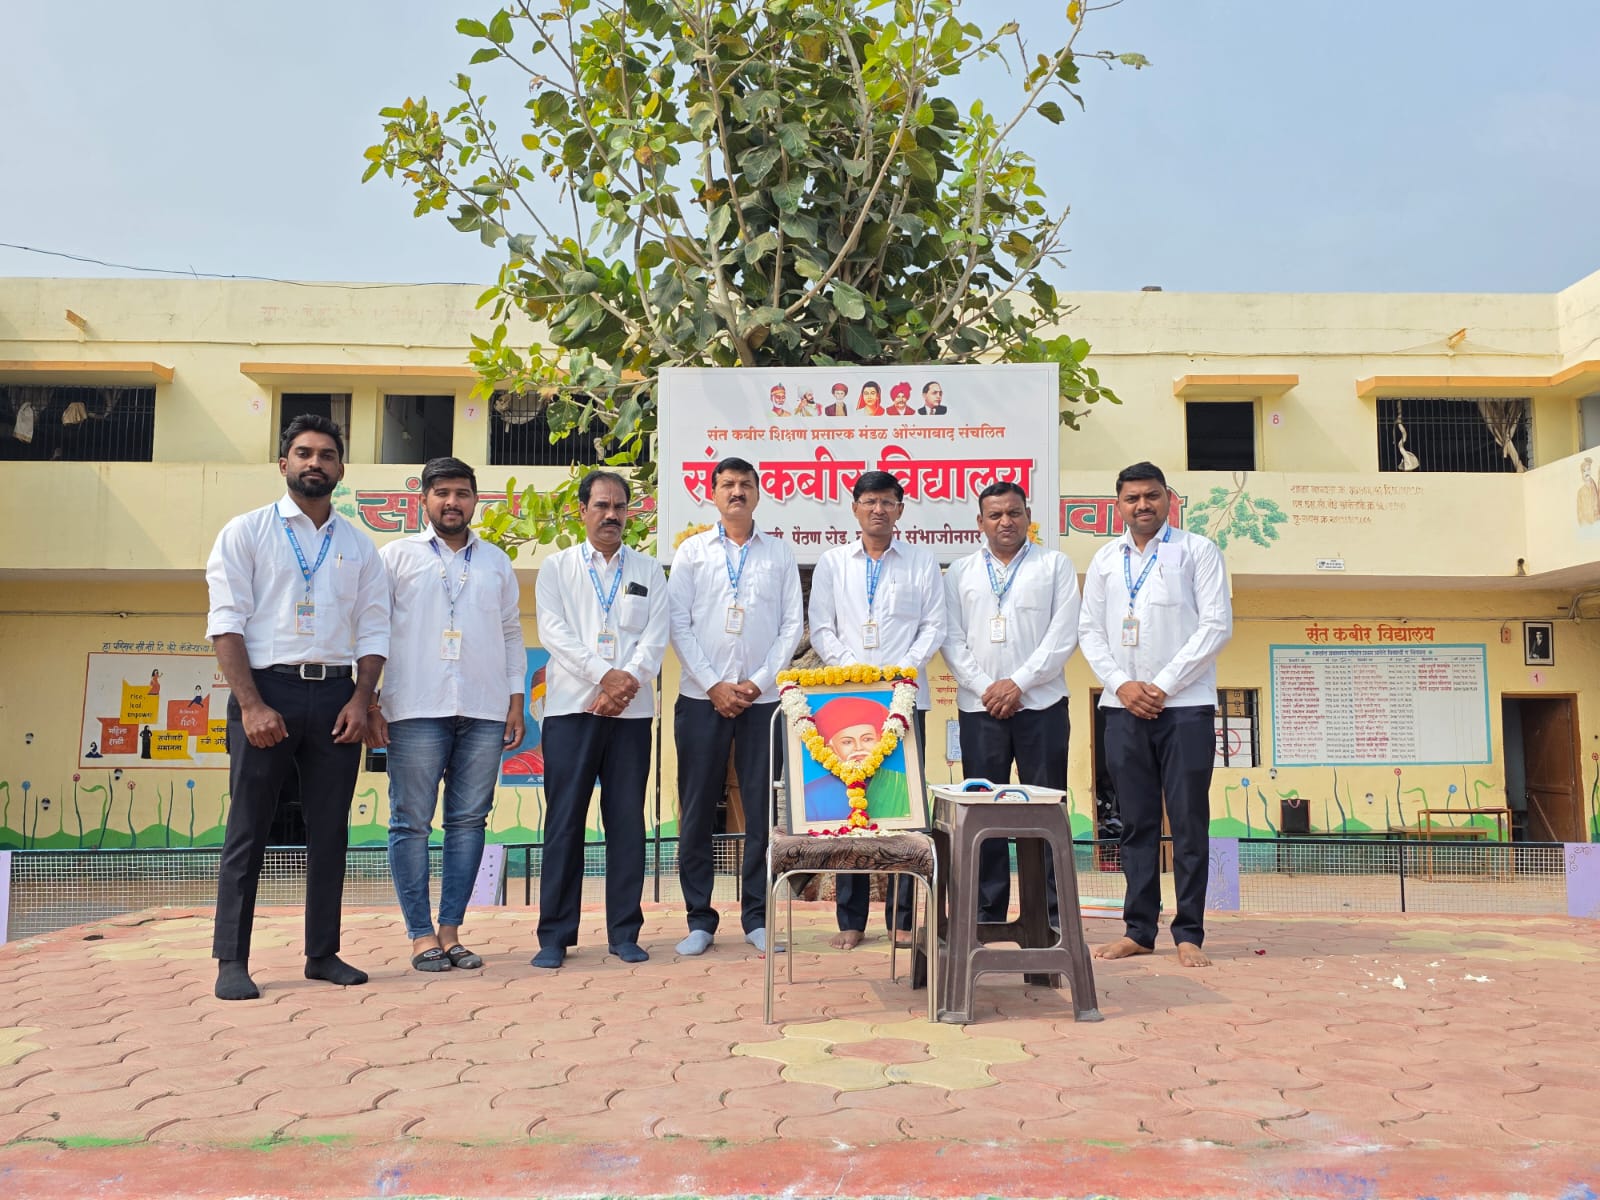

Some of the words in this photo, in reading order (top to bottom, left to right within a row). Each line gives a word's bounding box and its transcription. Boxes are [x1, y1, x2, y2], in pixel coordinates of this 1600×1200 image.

[707, 425, 728, 441] संत
[731, 425, 766, 441] कबीर
[769, 425, 808, 442] शिक्षण
[811, 428, 855, 441] प्रसारक
[858, 424, 888, 440] मंडळ
[892, 423, 954, 441] औरंगाबाद
[958, 423, 1006, 440] संचलित
[792, 525, 822, 545] पैठण
[905, 523, 982, 545] संभाजीनगर
[1305, 622, 1329, 644] संत
[1333, 623, 1372, 644] कबीर
[1376, 623, 1436, 643] विद्यालय
